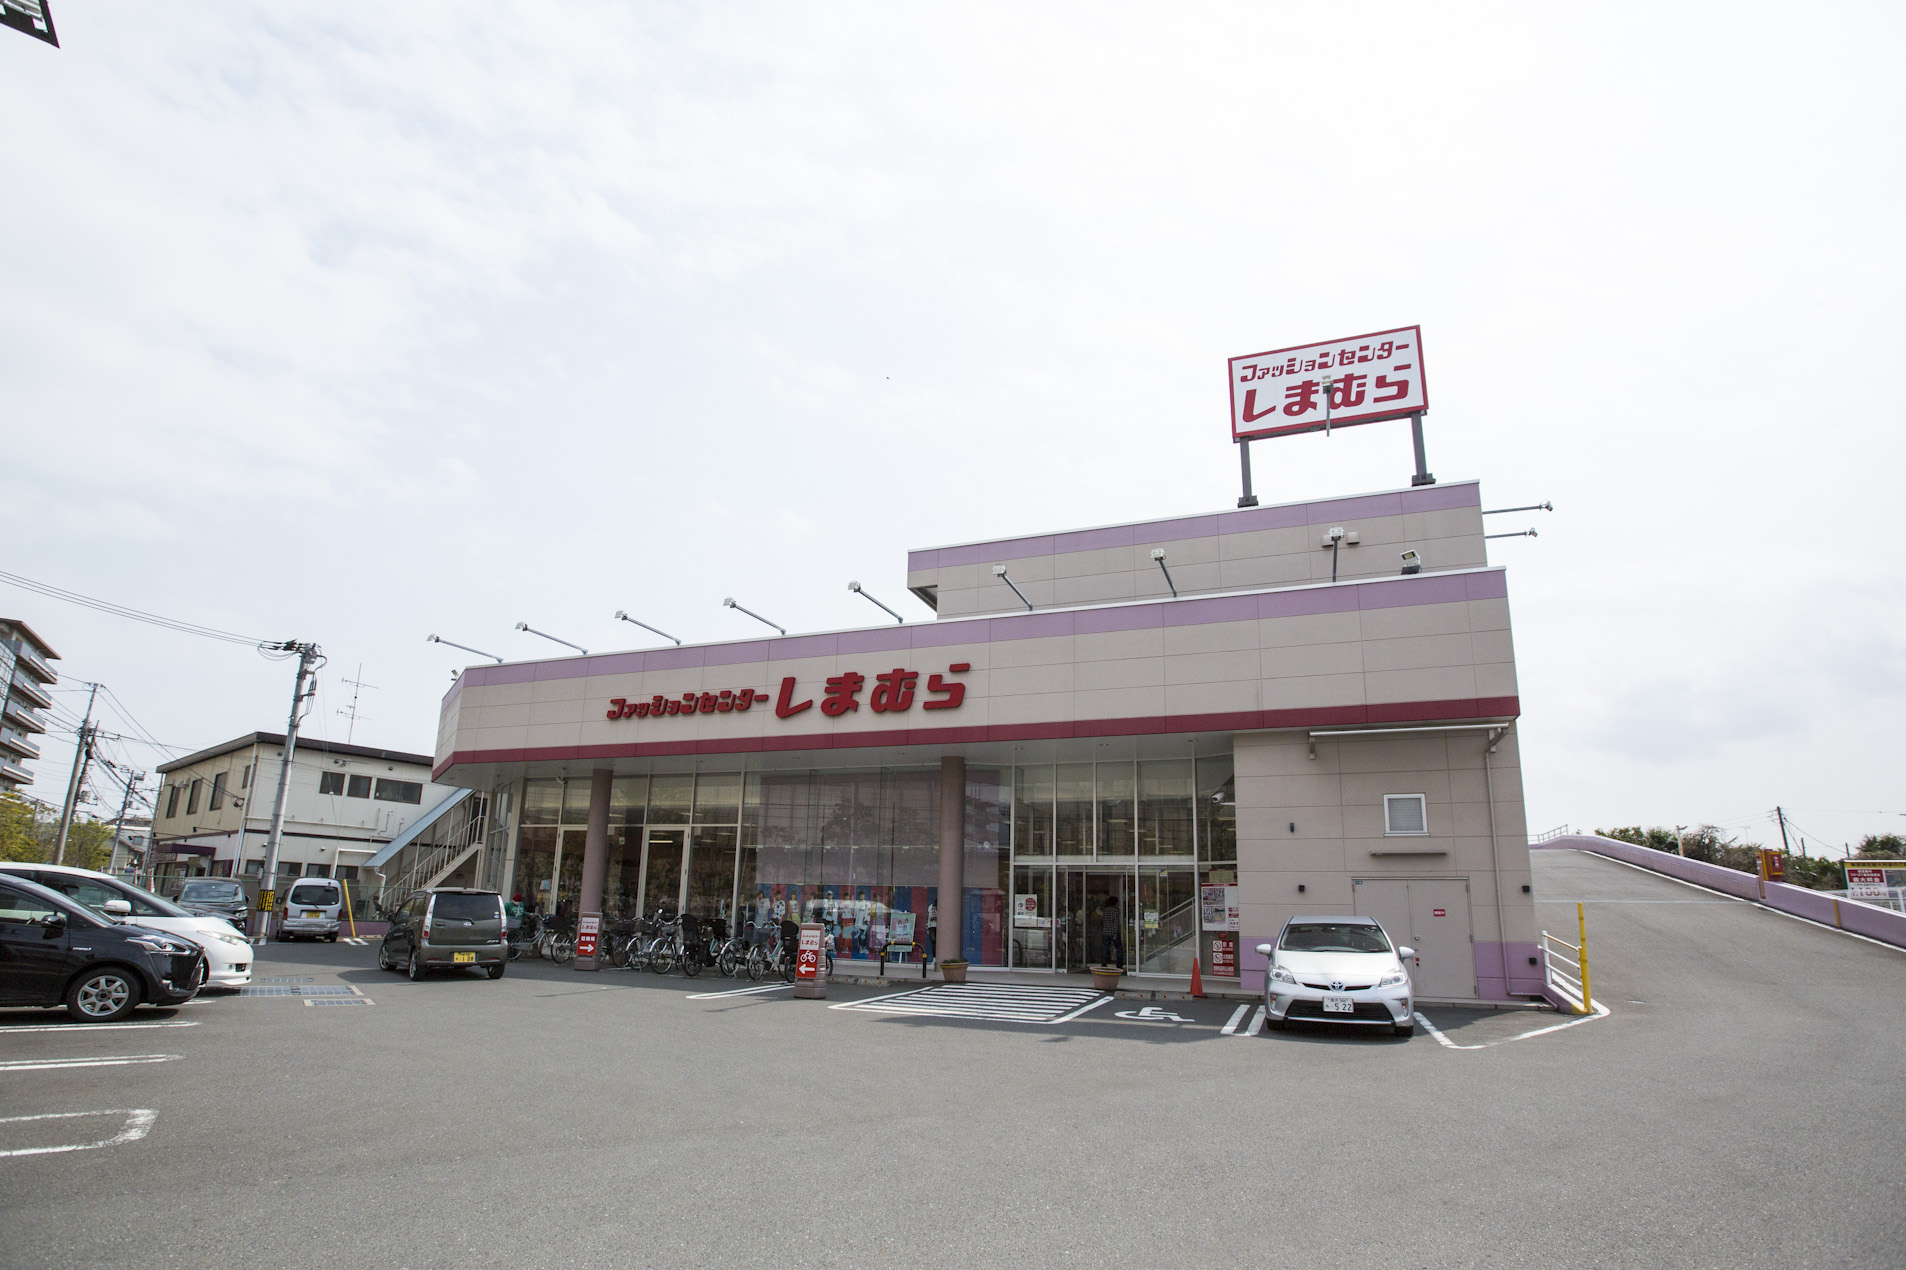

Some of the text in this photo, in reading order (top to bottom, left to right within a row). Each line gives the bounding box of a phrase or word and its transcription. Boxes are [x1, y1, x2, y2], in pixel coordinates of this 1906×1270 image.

[1240, 341, 1410, 382] ファッションセンター
[1242, 363, 1412, 423] しまむら
[606, 688, 769, 720] ファッションセンター
[775, 662, 971, 719] しまむら
